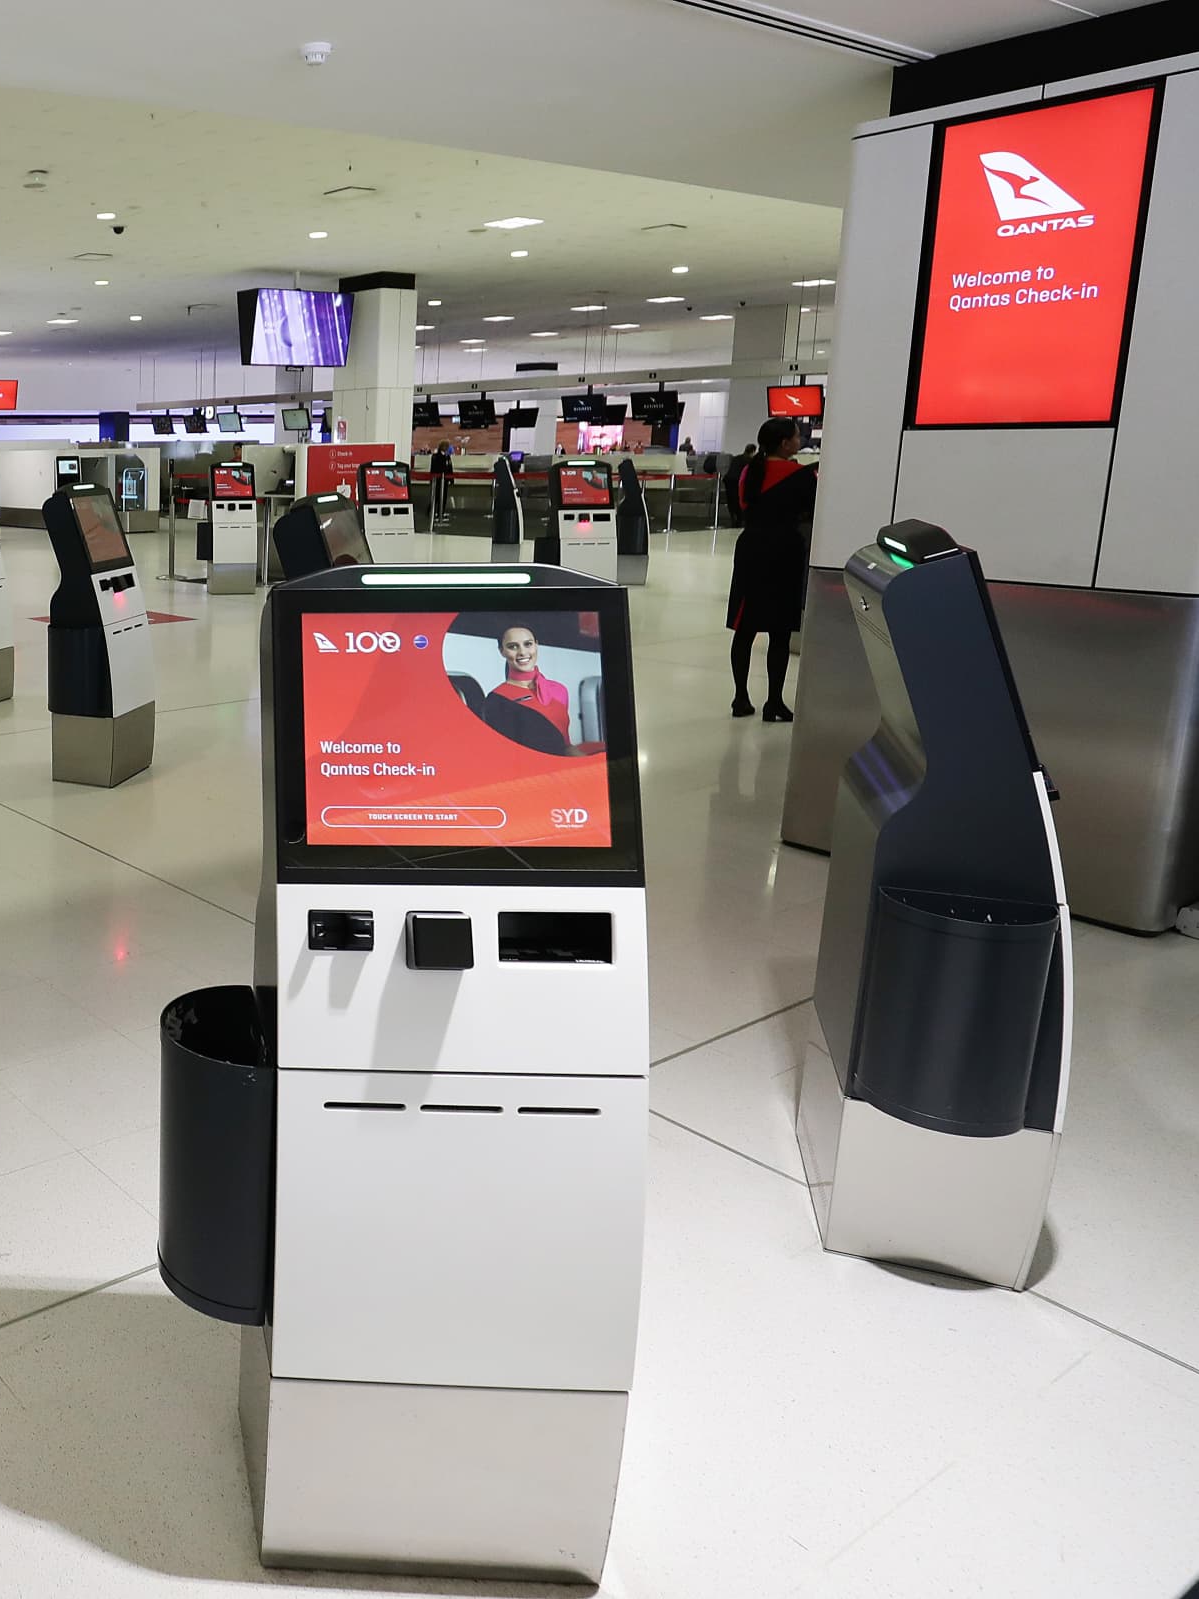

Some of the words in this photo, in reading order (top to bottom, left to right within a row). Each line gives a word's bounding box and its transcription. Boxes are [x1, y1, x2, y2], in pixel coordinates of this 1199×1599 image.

[996, 215, 1094, 237] QANTAS
[952, 268, 1031, 288] Welcome
[1036, 266, 1054, 280] to
[950, 293, 1010, 312] Qantas
[1015, 283, 1098, 304] Check-in
[139, 471, 144, 480] 7
[345, 631, 401, 653] 100
[320, 741, 384, 754] Welcome
[386, 742, 400, 754] to
[320, 762, 370, 777] Qantas
[373, 762, 435, 776] Check-in
[551, 809, 588, 823] SYD
